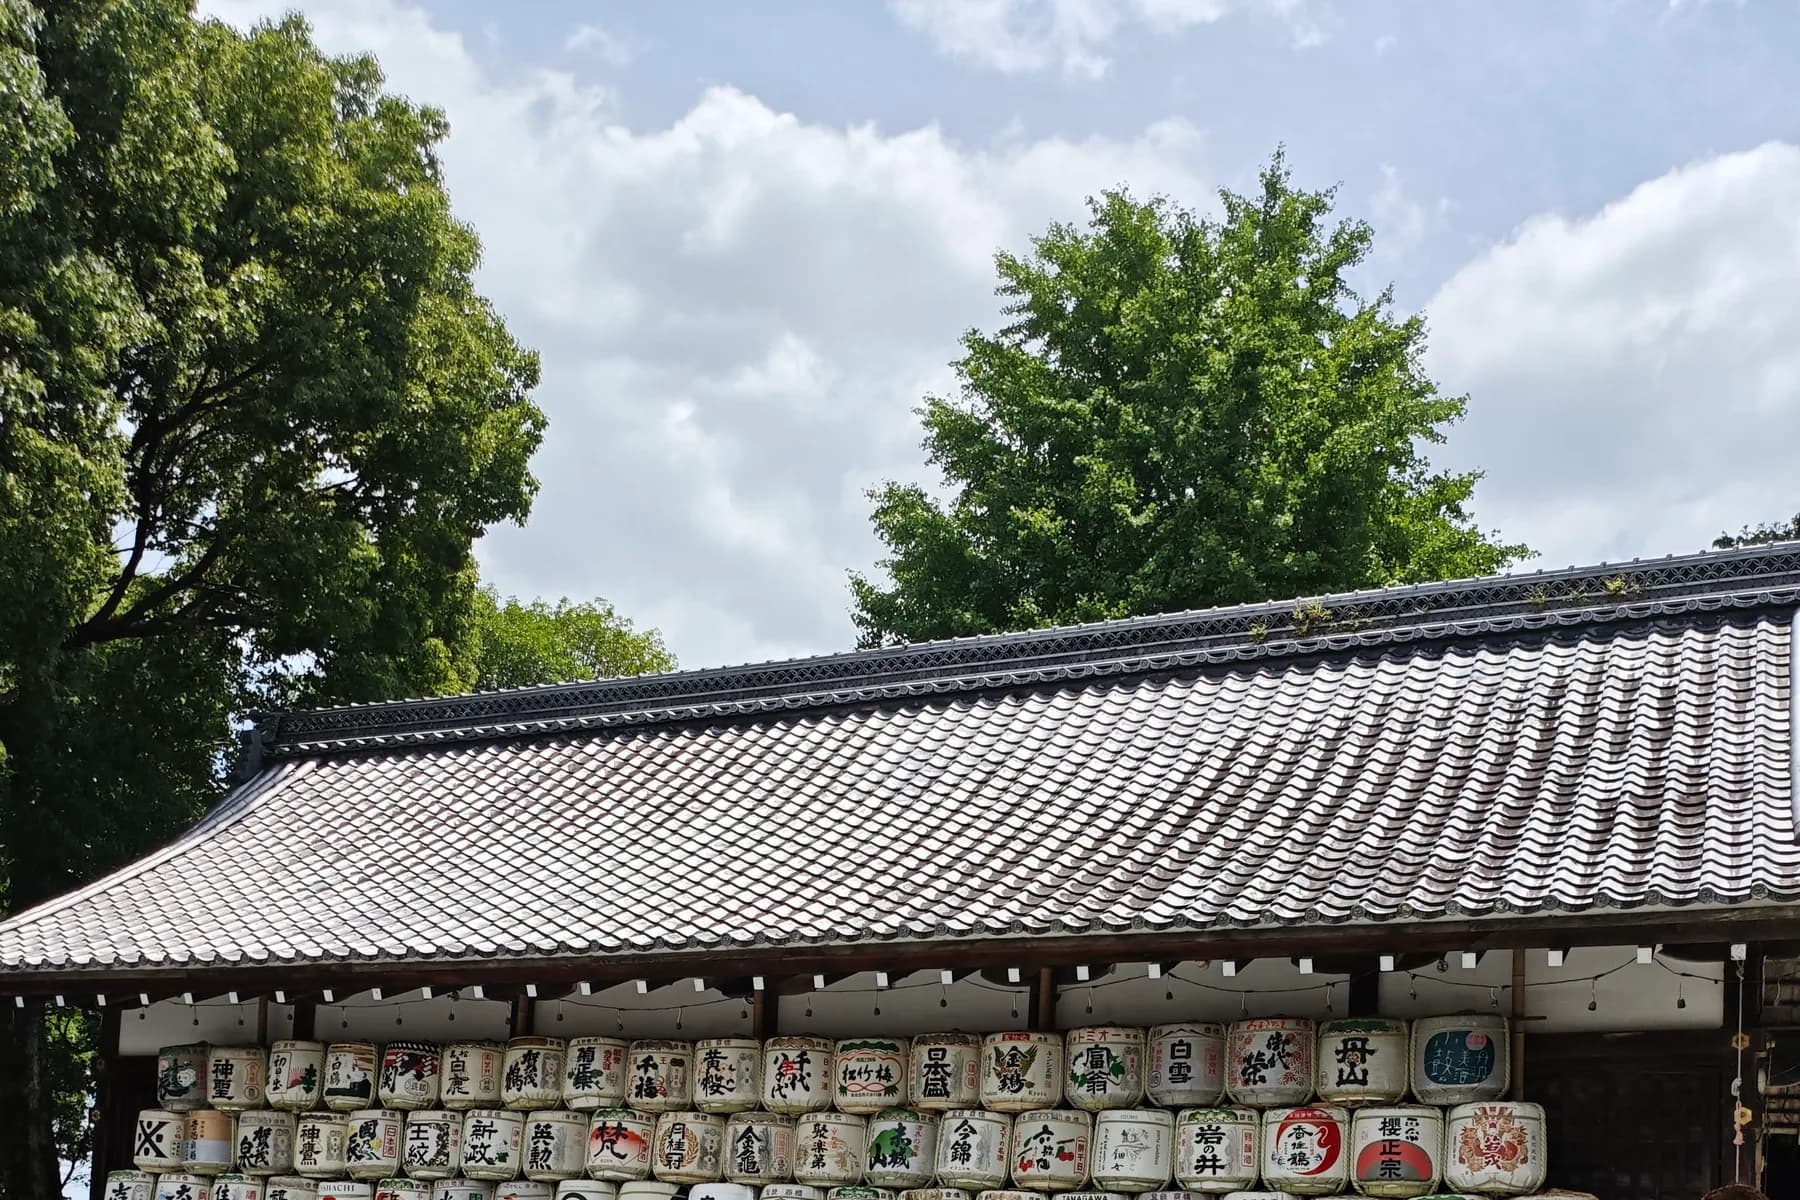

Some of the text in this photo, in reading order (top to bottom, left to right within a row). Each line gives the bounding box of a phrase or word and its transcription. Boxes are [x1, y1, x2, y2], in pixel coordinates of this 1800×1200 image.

[1078, 1030, 1121, 1042] トミオー
[212, 1059, 234, 1100] 神聖
[446, 1057, 470, 1096] 白鹿
[575, 1046, 599, 1091] 菊正宗
[634, 1054, 659, 1099] 千福
[820, 1057, 829, 1091] 日本酒
[842, 1063, 894, 1083] 松竹梅
[922, 1047, 952, 1099] 日本盛
[1083, 1044, 1111, 1095] 富翁
[1168, 1039, 1194, 1084] 白雪
[1335, 1037, 1375, 1087] 丹山
[300, 1125, 322, 1166] 神鷹
[385, 1127, 397, 1157] 日本酒
[407, 1124, 429, 1165] 王紋
[464, 1119, 498, 1165] 新政
[530, 1123, 554, 1170] 英勲
[593, 1121, 630, 1160] 梵
[666, 1123, 687, 1170] 月桂冠
[950, 1119, 977, 1166] 今錦
[1193, 1124, 1227, 1176] 岩の井
[1286, 1125, 1313, 1167] 香住鶴
[1378, 1117, 1402, 1178] 櫻正宗
